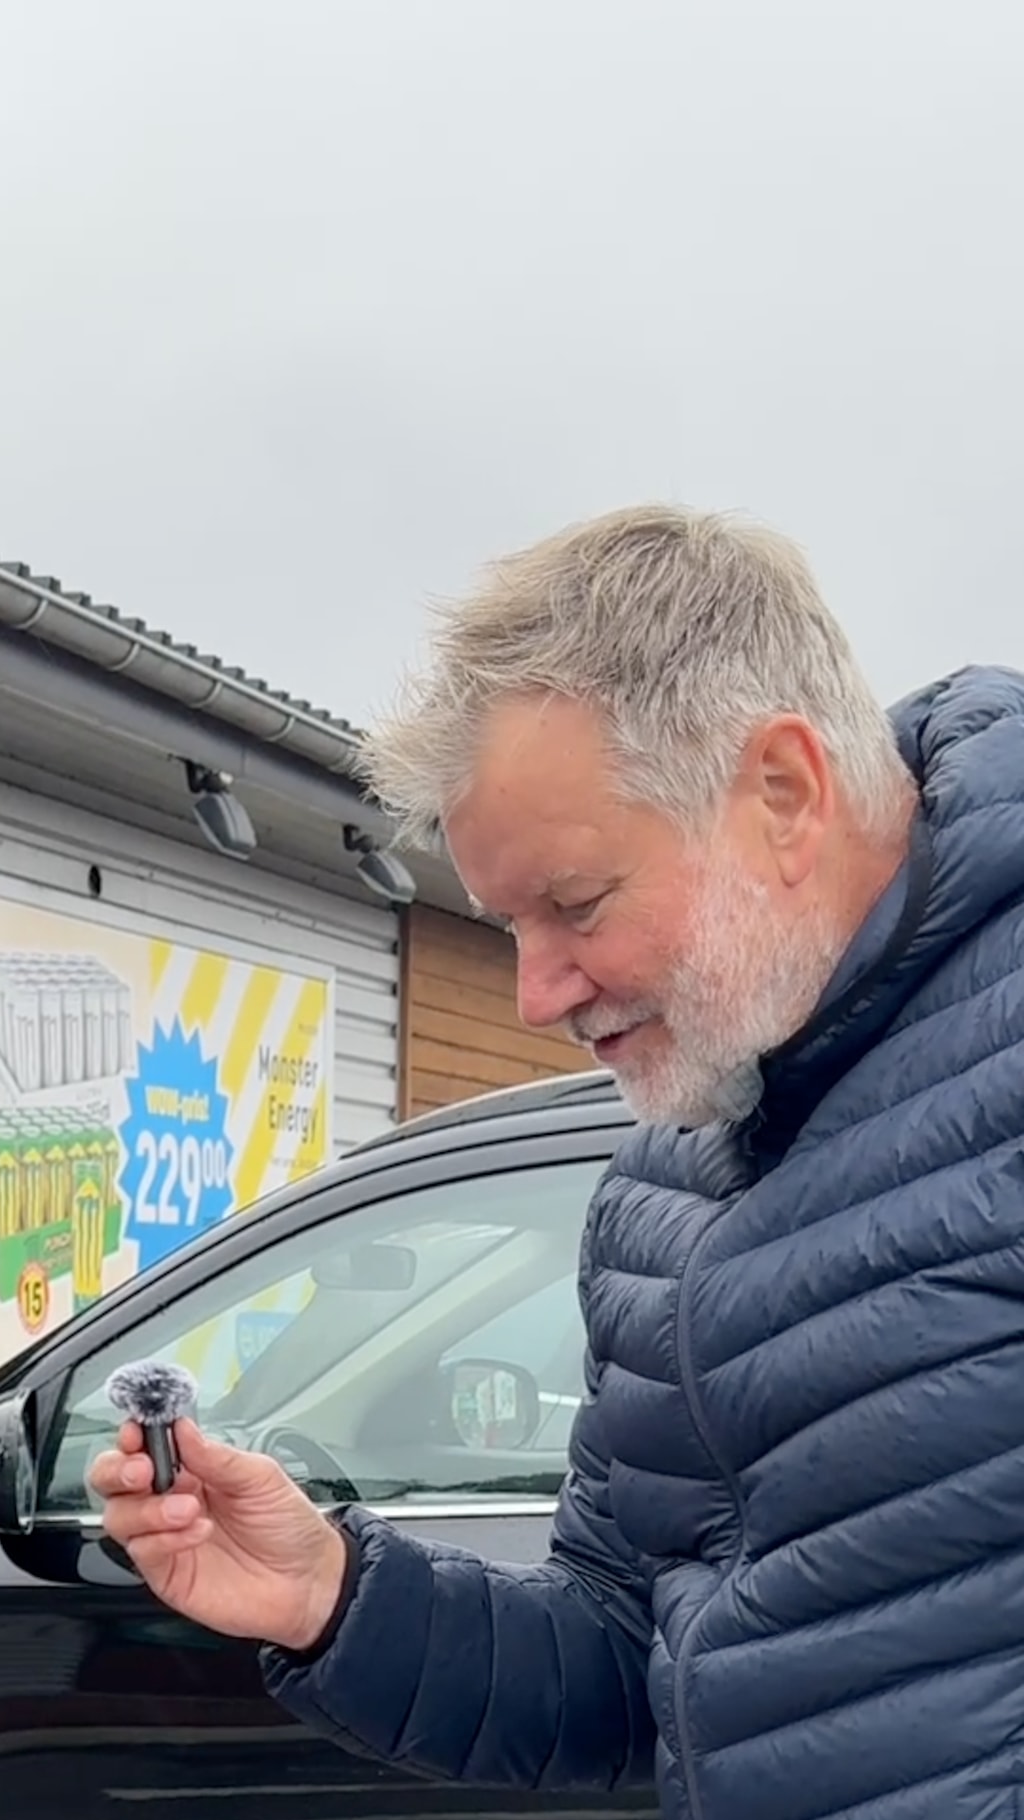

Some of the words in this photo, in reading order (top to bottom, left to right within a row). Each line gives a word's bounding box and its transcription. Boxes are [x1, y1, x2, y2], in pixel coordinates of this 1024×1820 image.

[258, 1044, 318, 1088] Monster
[268, 1095, 319, 1144] Energy
[25, 1281, 43, 1316] 15
